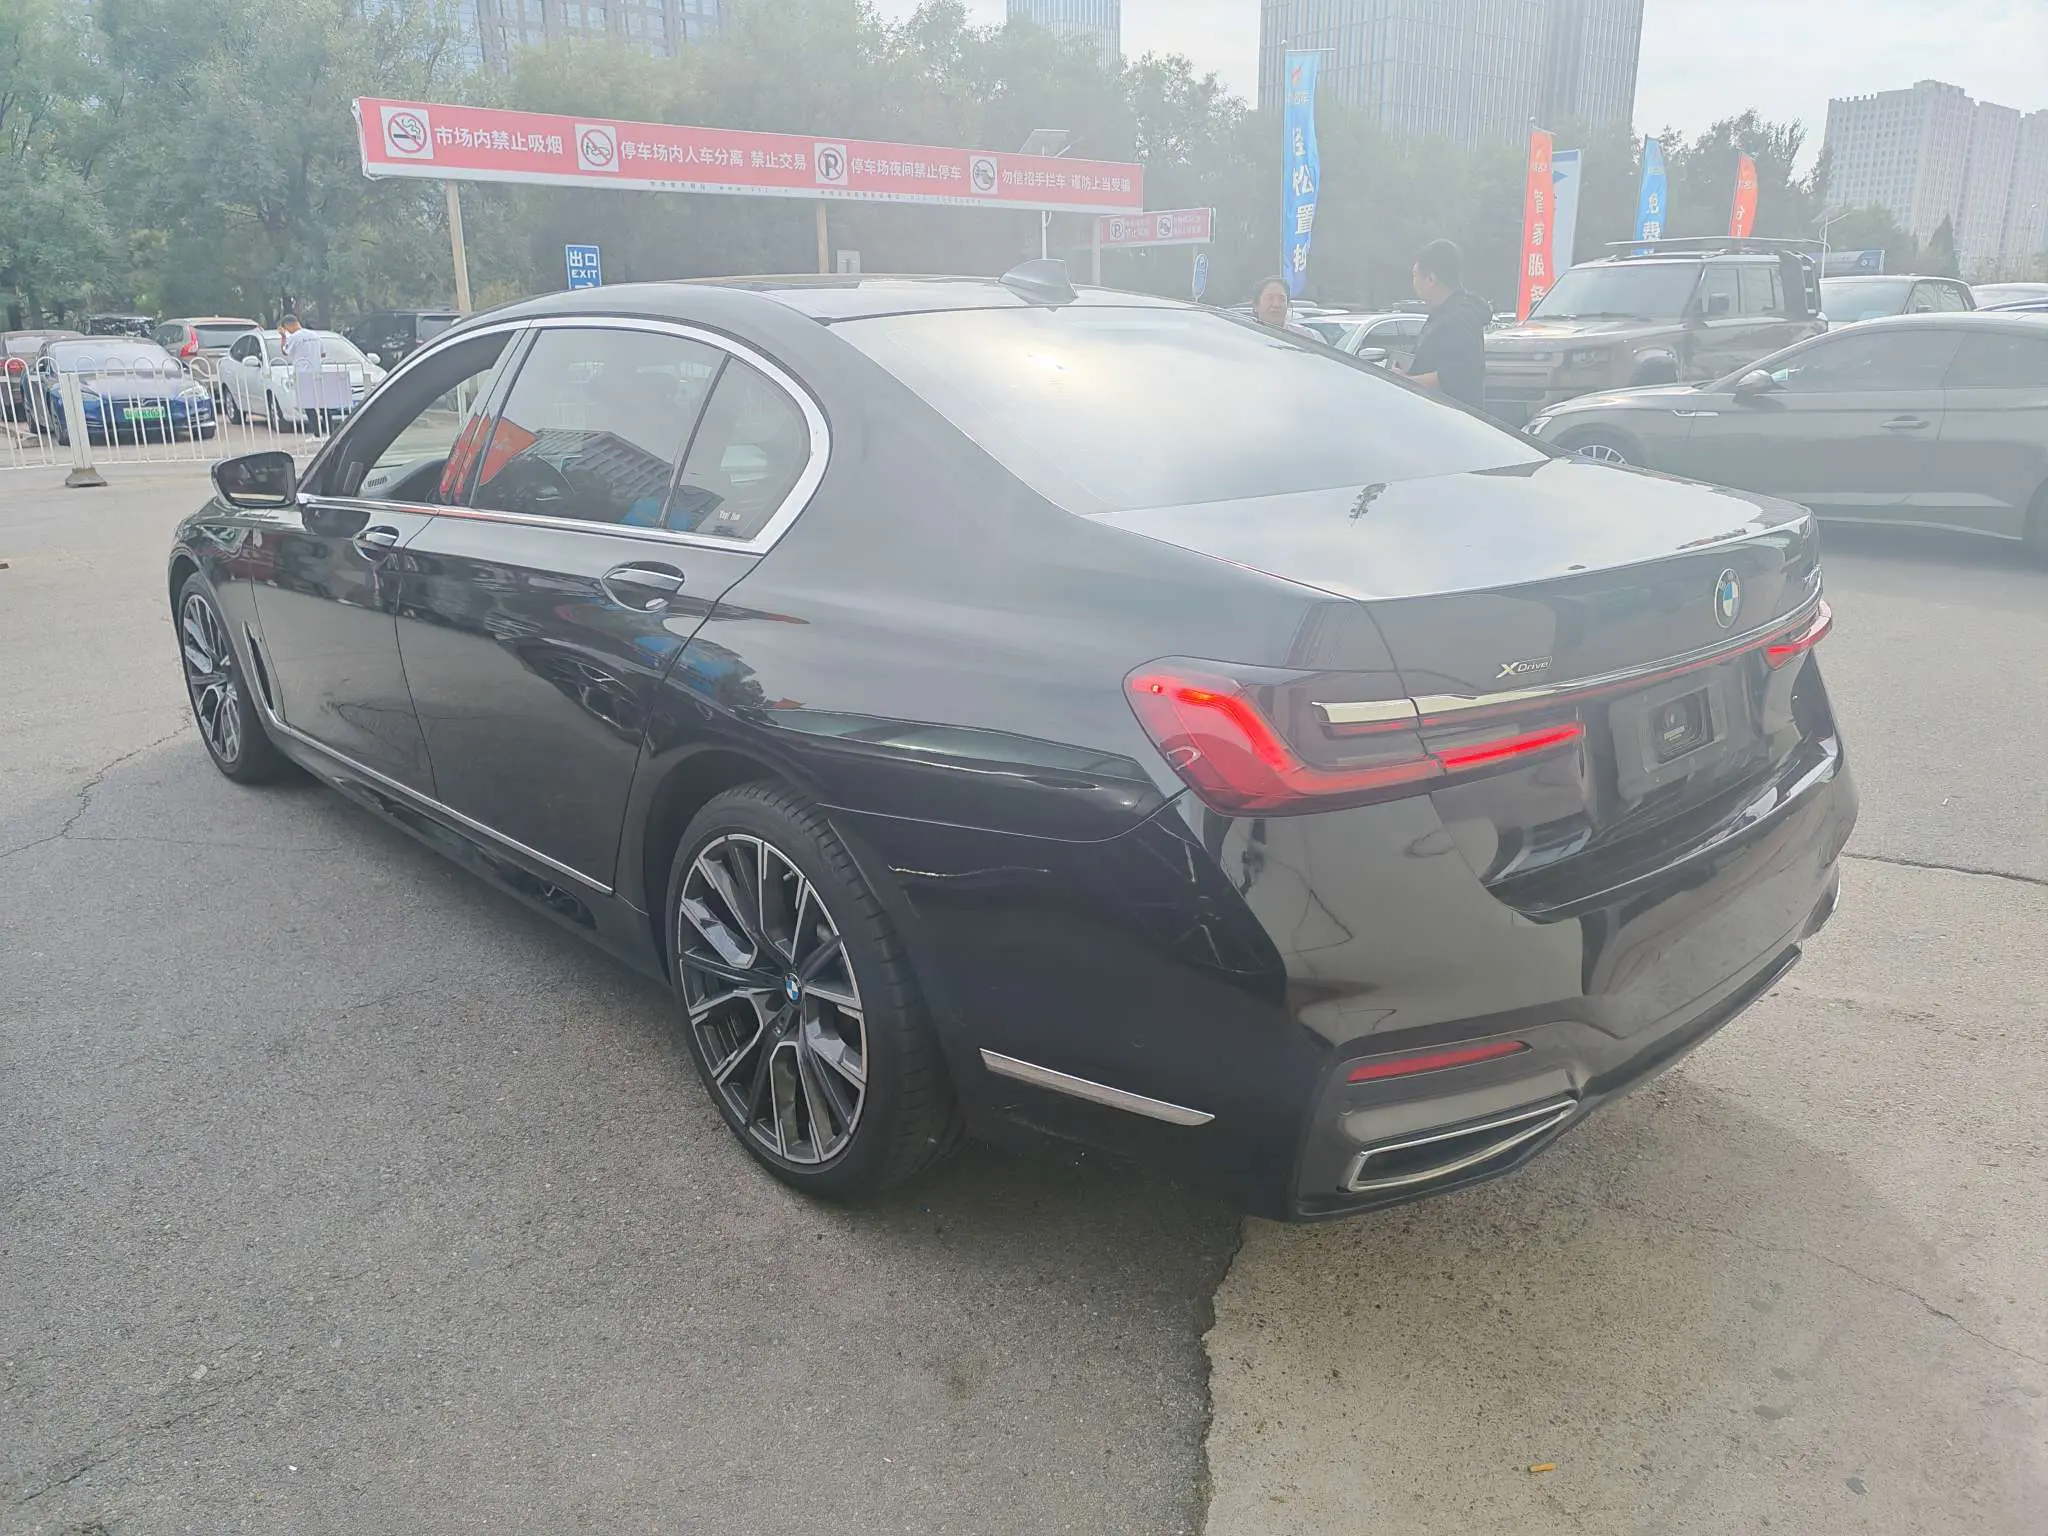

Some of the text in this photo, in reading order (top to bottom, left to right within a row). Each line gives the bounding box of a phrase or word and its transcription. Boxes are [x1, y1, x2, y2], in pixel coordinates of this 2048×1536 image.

[434, 125, 564, 155] 市场内禁止吸烟
[620, 140, 807, 171] 停车场内人车分离 禁止交易
[850, 157, 962, 181] 停车场夜间禁止停车
[569, 249, 597, 267] 出口
[571, 269, 597, 279] EXIT
